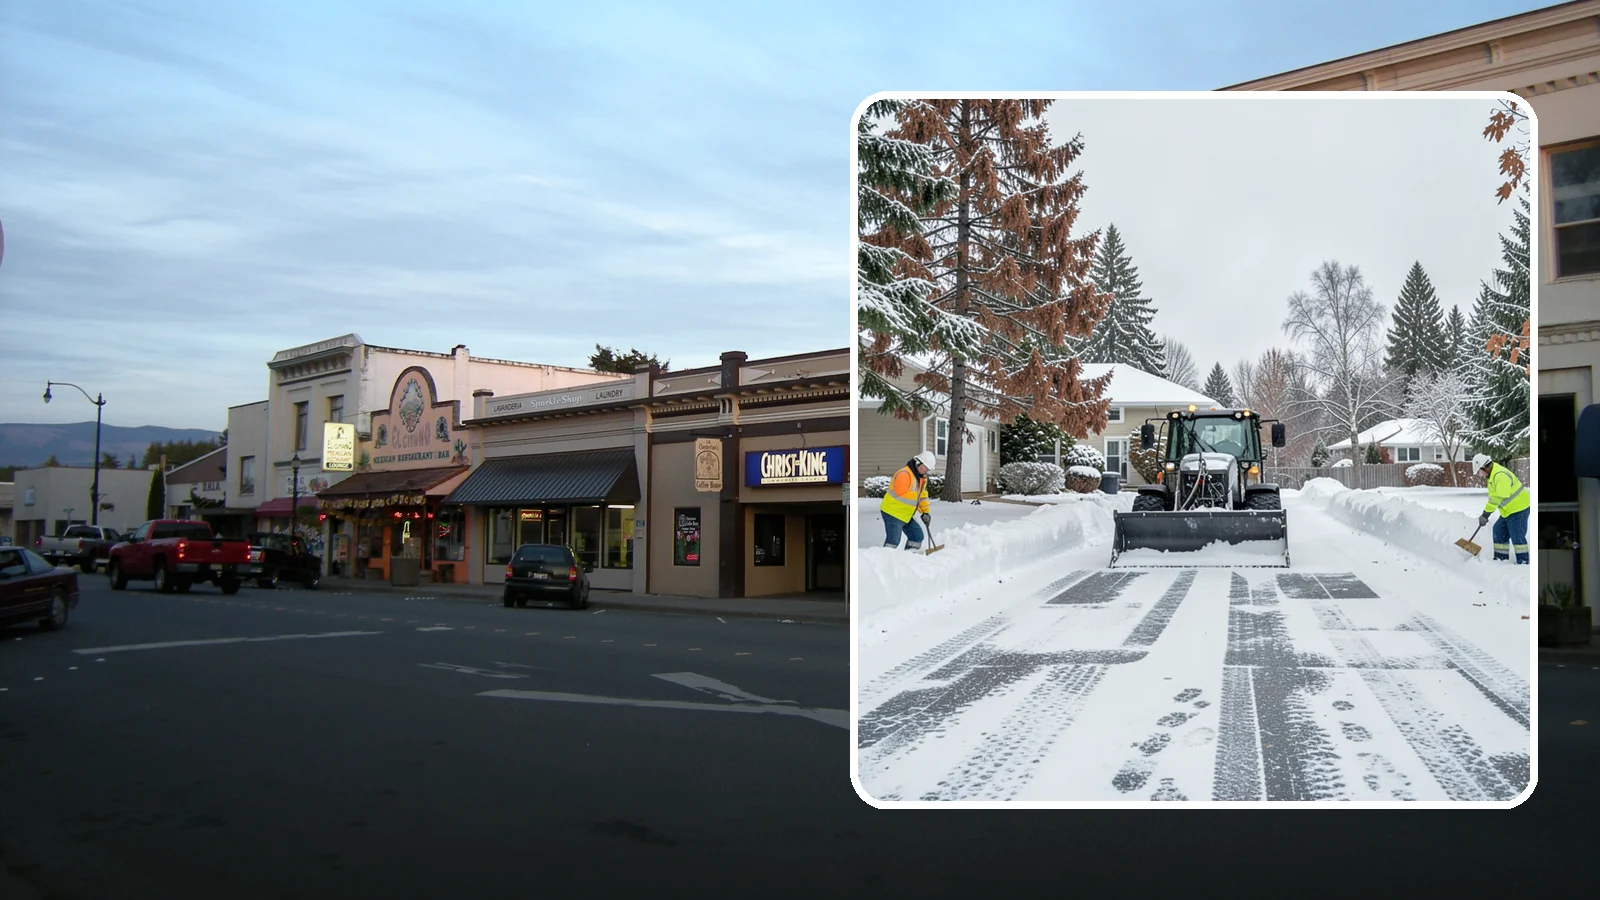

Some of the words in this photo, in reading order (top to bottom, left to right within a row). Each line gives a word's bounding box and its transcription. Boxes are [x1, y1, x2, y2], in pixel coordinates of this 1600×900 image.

[531, 396, 560, 409] Sparkle
[561, 394, 583, 404] Shop
[595, 389, 623, 400] LAUNDRY
[493, 402, 522, 413] LAVANDERIA
[373, 455, 396, 464] MEXICAN
[397, 451, 433, 462] RESTAURANT
[437, 450, 450, 459] BAR
[761, 452, 798, 478] CHRIST
[799, 450, 827, 476] KING
